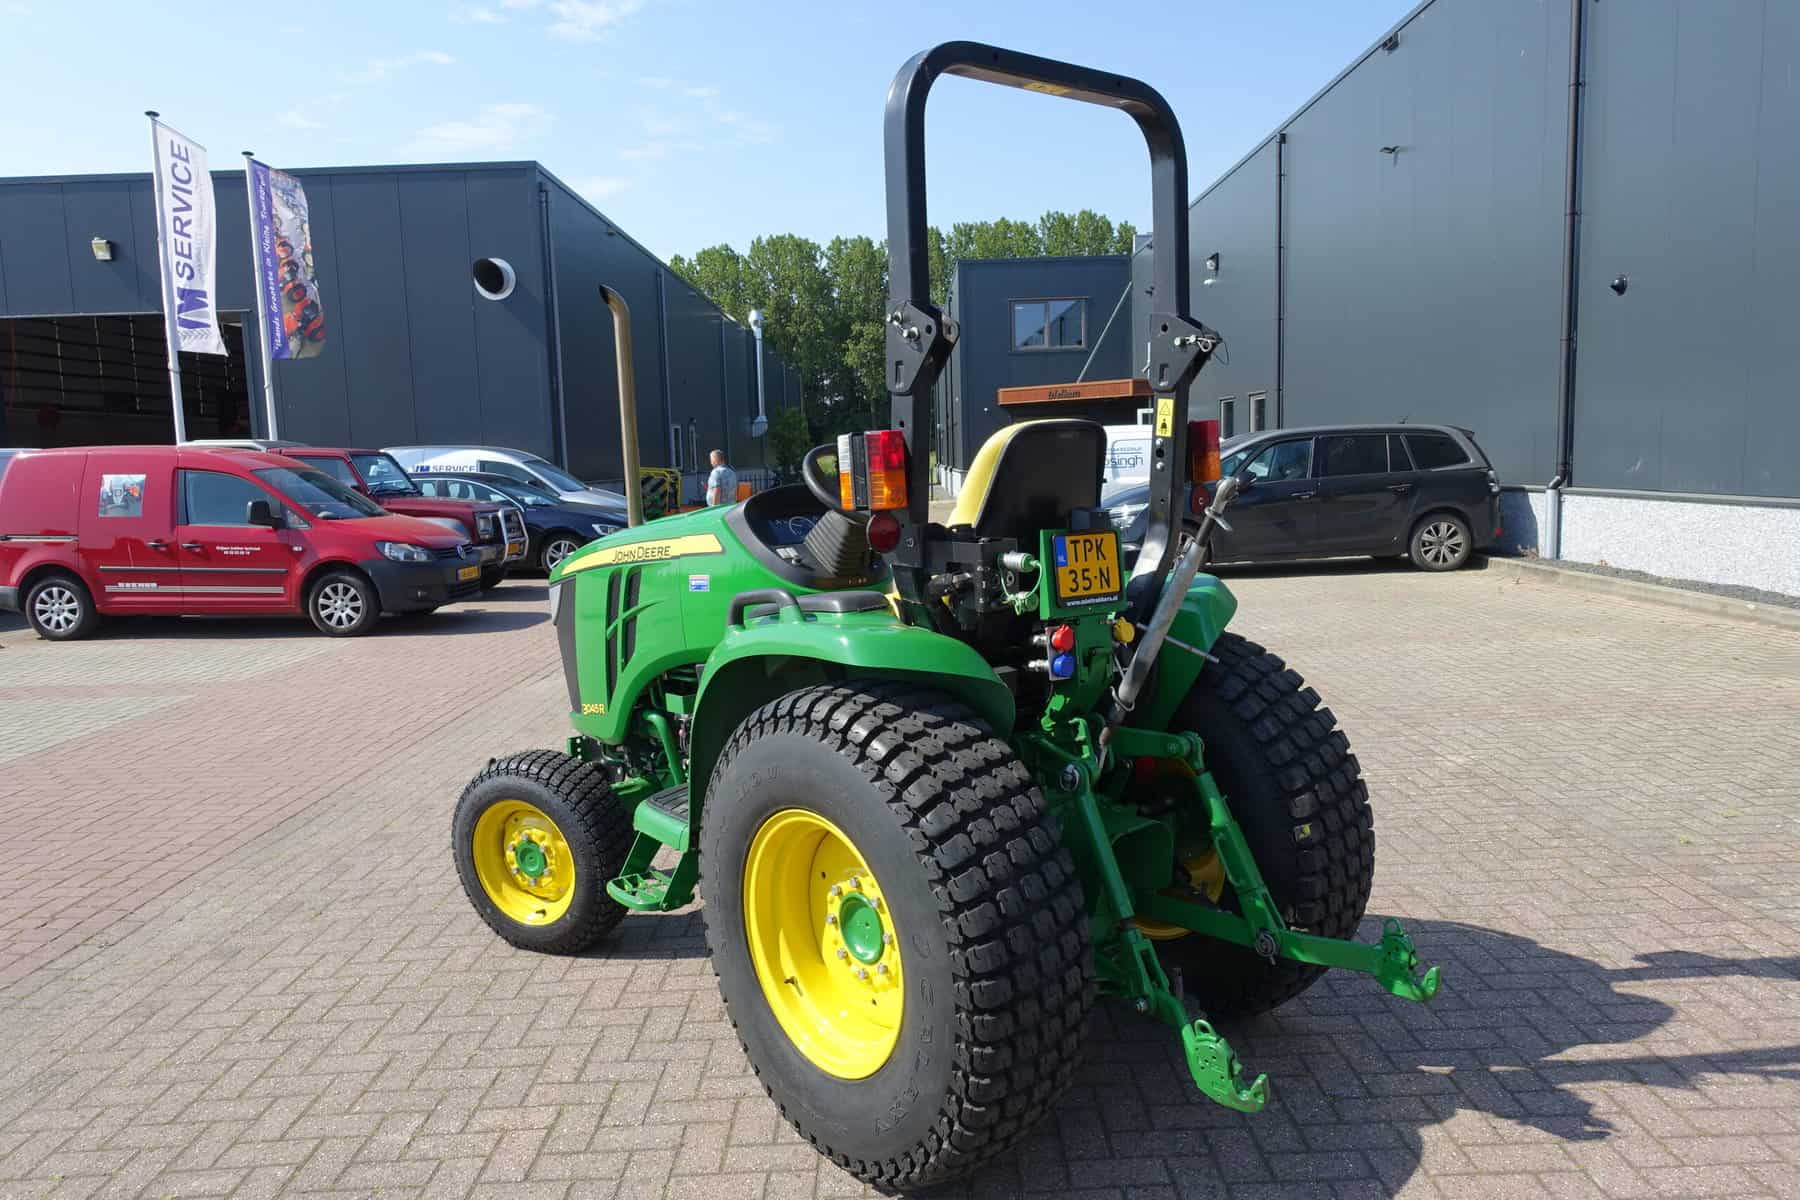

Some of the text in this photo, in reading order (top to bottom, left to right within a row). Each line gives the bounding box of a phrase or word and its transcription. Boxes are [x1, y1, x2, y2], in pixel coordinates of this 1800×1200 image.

[170, 139, 196, 281] SERVICE
[432, 465, 477, 473] SERVICE
[612, 545, 671, 562] JOHN DEERE
[1070, 538, 1106, 562] TPK
